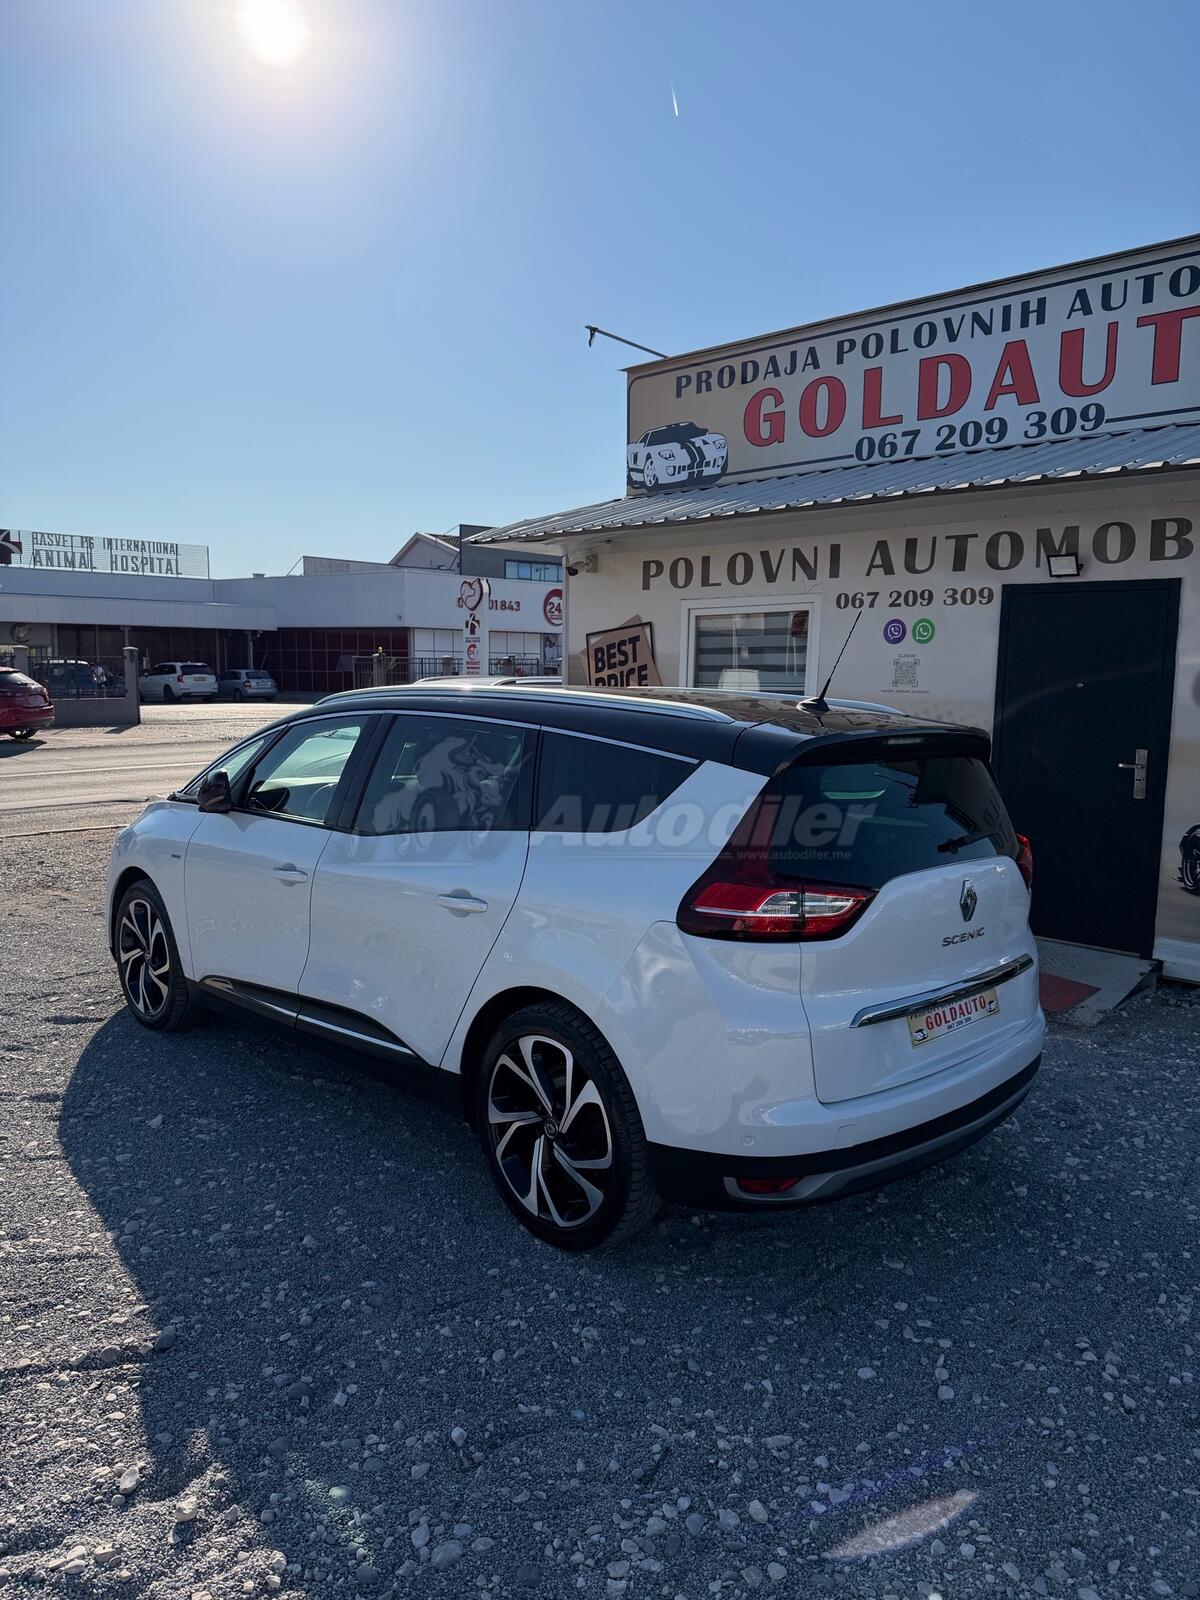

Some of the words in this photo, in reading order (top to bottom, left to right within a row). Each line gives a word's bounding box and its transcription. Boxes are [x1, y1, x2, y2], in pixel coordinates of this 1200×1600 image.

[675, 346, 821, 398] PRODAJA
[836, 297, 1048, 366] POLOVNIH
[1066, 265, 1200, 319] AUTO
[743, 305, 1200, 448] GOLDAUT
[854, 429, 921, 462] 067
[935, 417, 1009, 452] 209
[1024, 402, 1107, 439] 309
[34, 550, 97, 569] ANIMAL
[110, 555, 182, 575] HOSPITAL
[103, 537, 180, 555] INTERNATIONAL
[641, 543, 842, 591] POLOVNI
[865, 517, 1194, 577] AUTOMOB
[835, 592, 880, 611] 067
[888, 589, 935, 608] 209
[943, 587, 995, 606] 309
[594, 635, 640, 674] BEST
[941, 926, 986, 947] SCENIC
[925, 995, 987, 1031] GOLDAUTO
